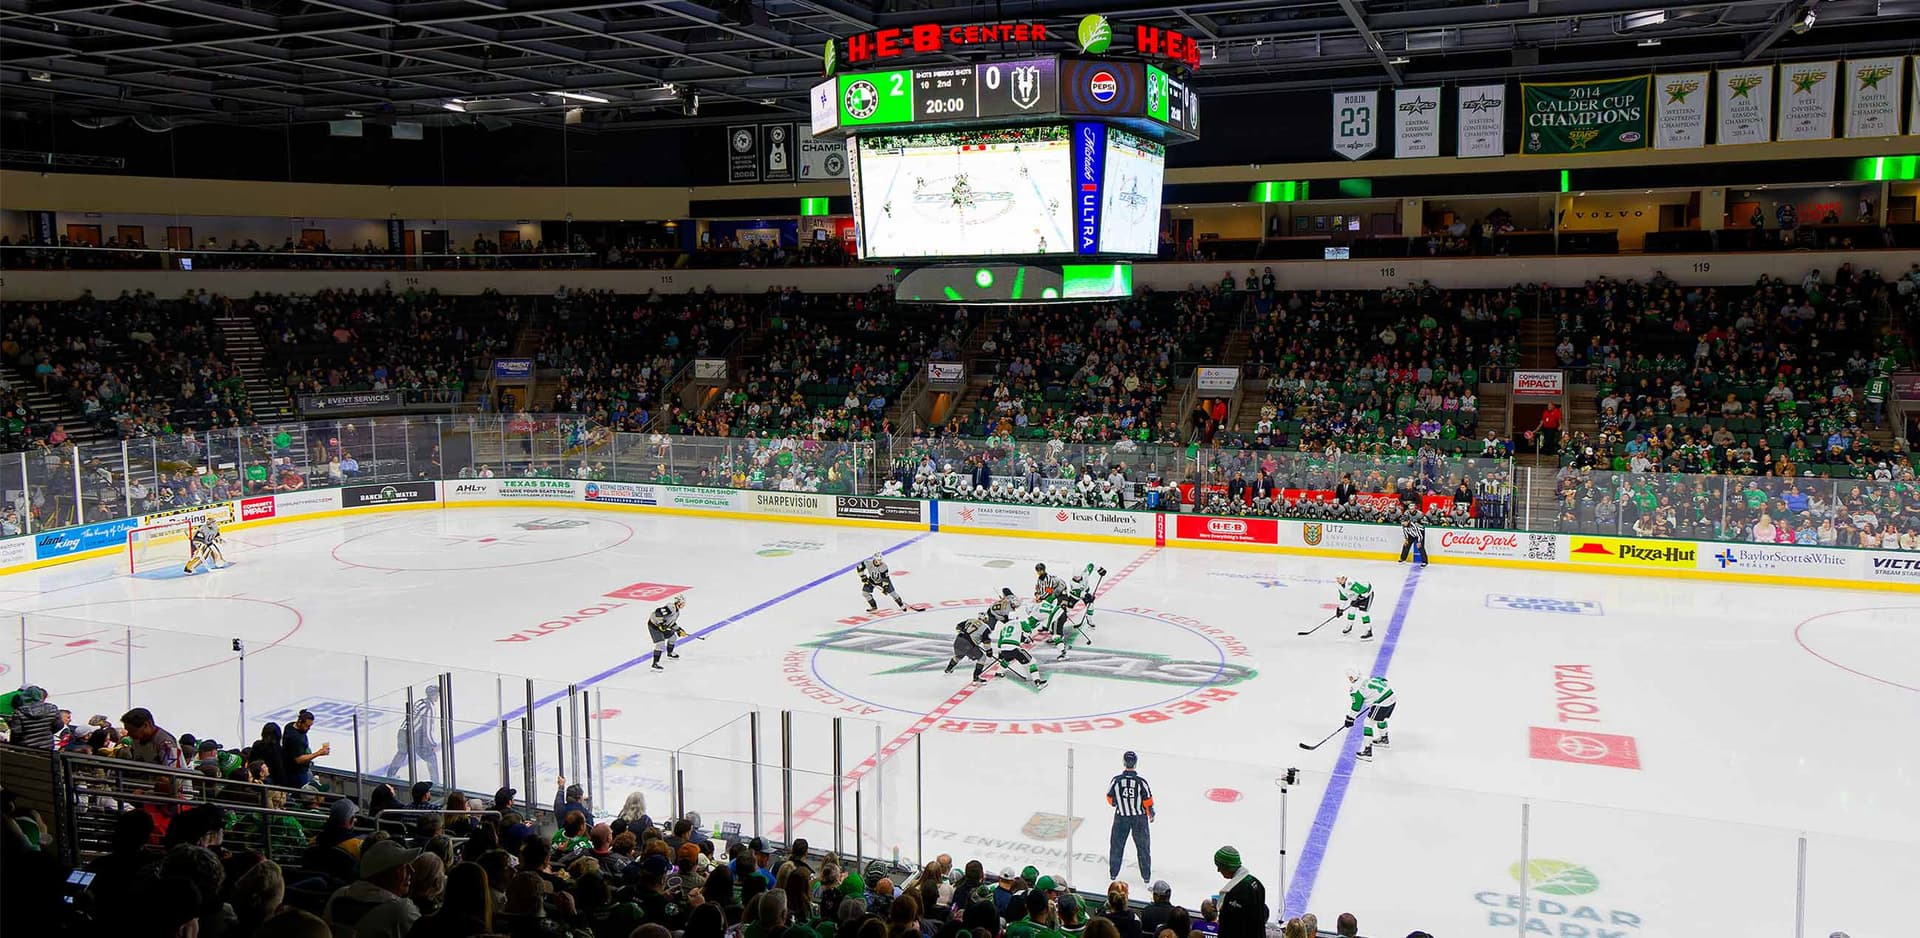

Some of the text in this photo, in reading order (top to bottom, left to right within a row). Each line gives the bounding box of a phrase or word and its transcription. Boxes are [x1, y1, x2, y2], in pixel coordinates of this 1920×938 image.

[949, 23, 1046, 45] CENTER
[1792, 71, 1827, 81] STARS
[1856, 67, 1894, 78] STARS
[920, 78, 967, 90] 10 2nd 7
[985, 67, 1000, 90] 0
[1728, 76, 1762, 87] STARS
[890, 73, 904, 97] 2
[1092, 83, 1115, 91] PEPSI
[1665, 82, 1699, 92] STARS
[1569, 87, 1600, 99] 2014
[1344, 95, 1366, 104] MORIN
[1536, 95, 1634, 112] CALDER CUP
[926, 98, 964, 114] 20:00
[1341, 107, 1370, 137] 23
[1529, 107, 1640, 127] CHAMPIONS
[1569, 130, 1600, 139] STARS
[774, 152, 782, 163] 3
[1576, 210, 1643, 219] VOLVO
[1083, 195, 1095, 249] ULTRA
[1380, 266, 1395, 278] 118
[1693, 262, 1710, 273] 119
[406, 277, 418, 285] 114
[661, 276, 673, 284] 115
[1518, 380, 1557, 388] IMPACT
[1872, 383, 1882, 393] 91
[360, 493, 382, 502] RANCH
[395, 491, 418, 499] WATER
[242, 501, 272, 510] COMMUNITY
[838, 497, 880, 508] BOND
[243, 505, 273, 517] IMPACT
[994, 508, 1030, 516] ORTHOPEDICS
[1071, 511, 1093, 522] Texas
[1113, 525, 1136, 535] Austin
[1325, 534, 1388, 543] ENVIRONMENTAL
[1441, 531, 1518, 551] Cedar Park
[55, 538, 81, 551] King
[1619, 544, 1695, 562] Pizza Hut
[493, 601, 628, 643] TOYOTA
[1121, 606, 1252, 657] AT CEDAR PARK
[782, 649, 884, 716] AT CEDAR PARK
[1553, 663, 1602, 723] TOYOTA
[938, 717, 1124, 735] CENTER
[1122, 787, 1135, 798] 49
[1474, 891, 1642, 929] CEDAR
